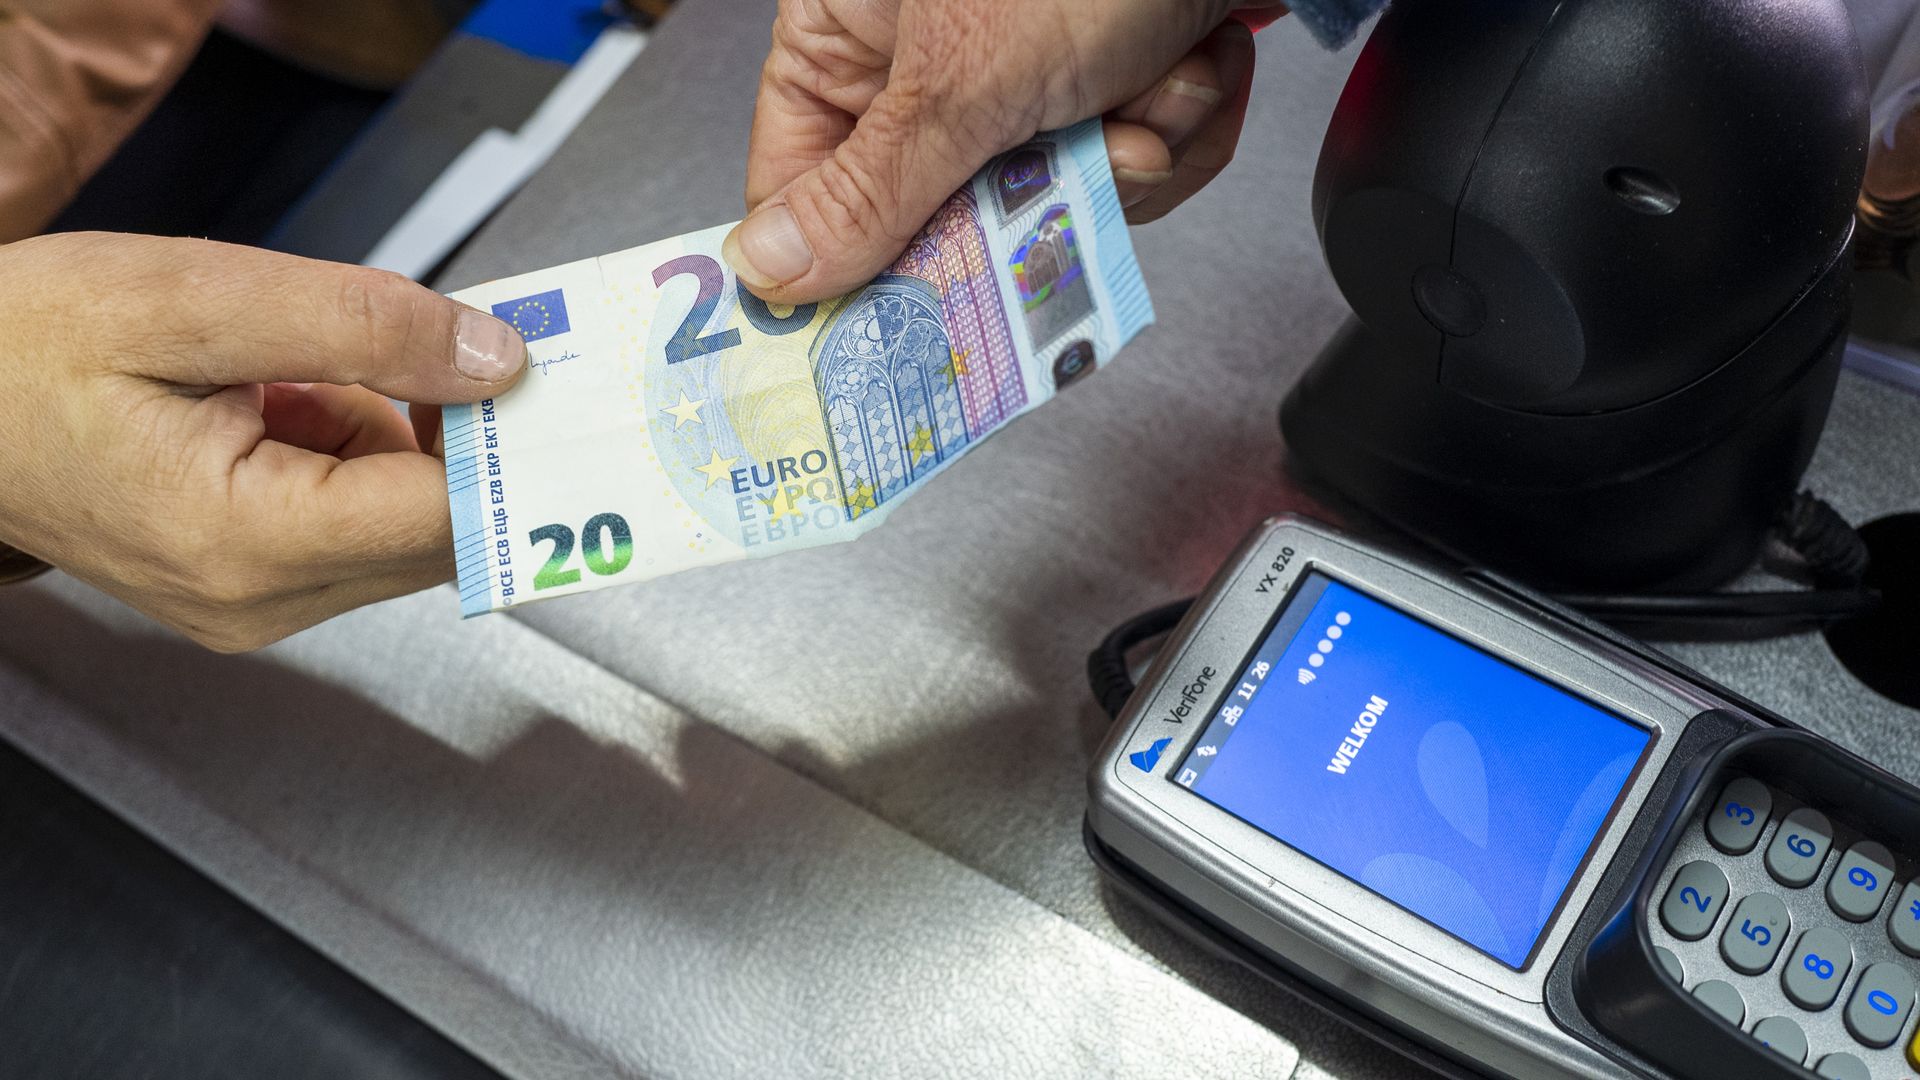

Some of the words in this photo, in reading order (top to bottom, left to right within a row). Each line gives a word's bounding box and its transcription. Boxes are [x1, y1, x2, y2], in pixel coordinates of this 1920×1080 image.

[487, 452, 501, 477] EKP
[730, 449, 828, 494] EURO
[490, 479, 504, 504] EZB
[493, 507, 508, 536] ЕЦБ
[497, 538, 511, 566] ECB
[529, 512, 633, 591] 20
[500, 569, 515, 597] BCE
[1255, 574, 1277, 595] VX
[1272, 547, 1295, 573] 820
[1164, 665, 1216, 725] VeriFone
[1326, 694, 1389, 775] WELKOM
[1725, 802, 1755, 826] 3
[1786, 834, 1816, 858] 6
[1848, 867, 1877, 892] 9
[1680, 886, 1712, 913] 2
[1740, 919, 1772, 946] 5
[1803, 953, 1834, 980] 8
[1867, 989, 1898, 1015] 0
